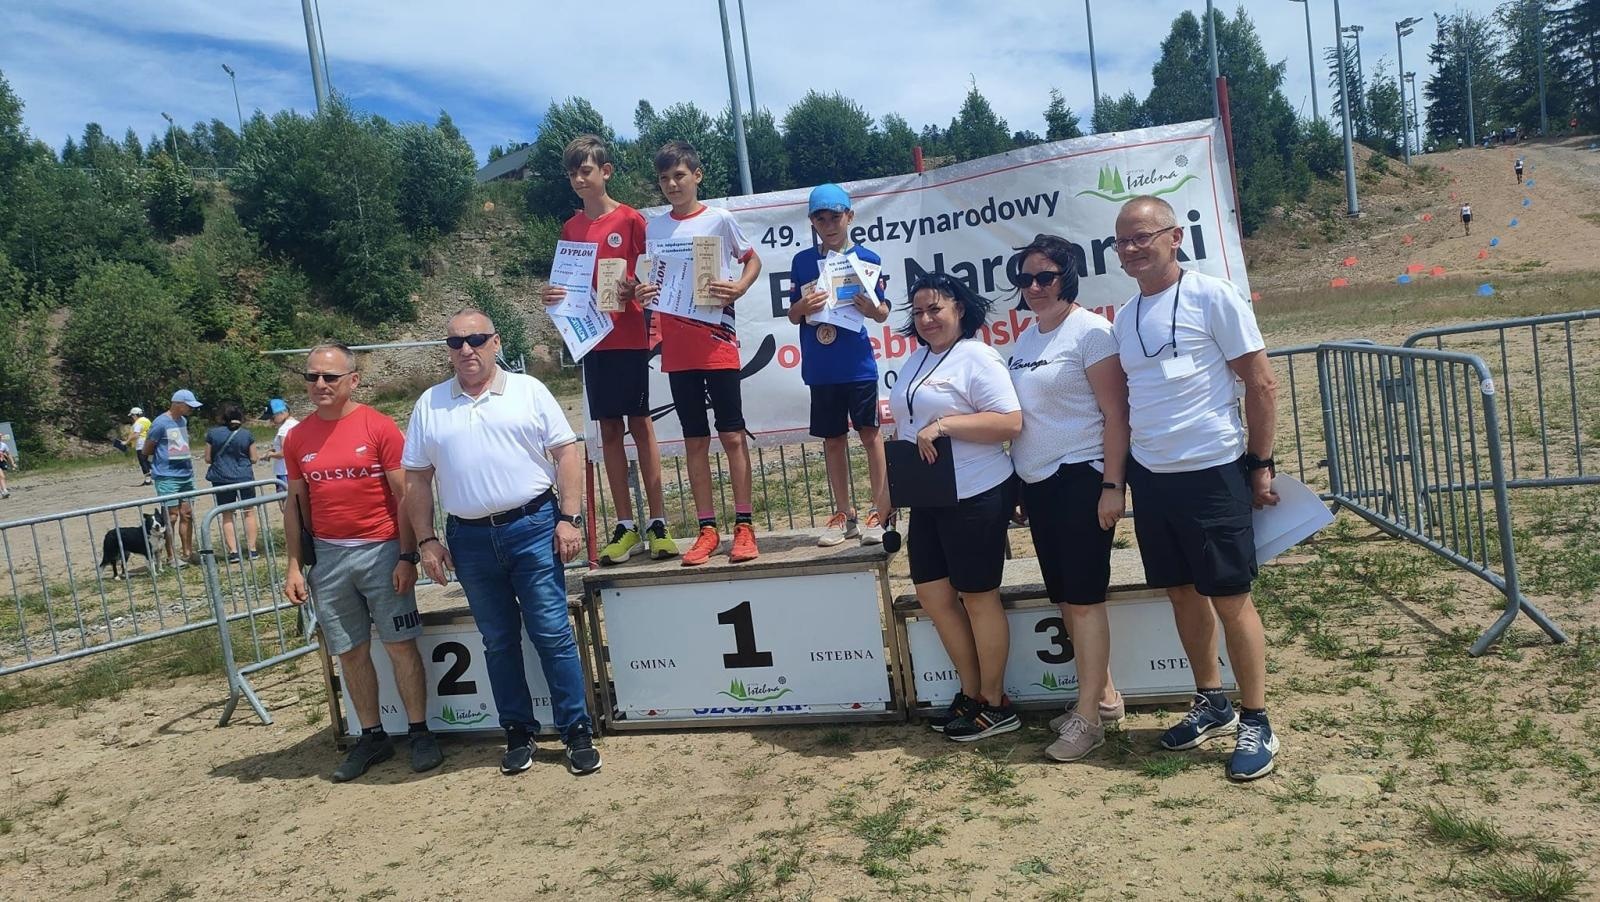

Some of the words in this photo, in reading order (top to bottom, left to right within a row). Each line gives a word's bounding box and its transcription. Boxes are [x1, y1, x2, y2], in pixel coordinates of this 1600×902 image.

[1127, 168, 1178, 190] Istebna
[761, 225, 801, 248] 49.
[811, 190, 1061, 249] ędzynarodowy
[560, 247, 594, 257] DYPLOM
[393, 610, 421, 632] PU
[717, 601, 774, 669] 1
[1034, 616, 1076, 665] 3
[630, 658, 677, 670] GMINA
[810, 649, 875, 662] ISTEBNA
[1150, 656, 1226, 671] ISTEA
[432, 641, 478, 697] 2
[923, 669, 961, 682] GMI
[748, 684, 780, 696] Istebna
